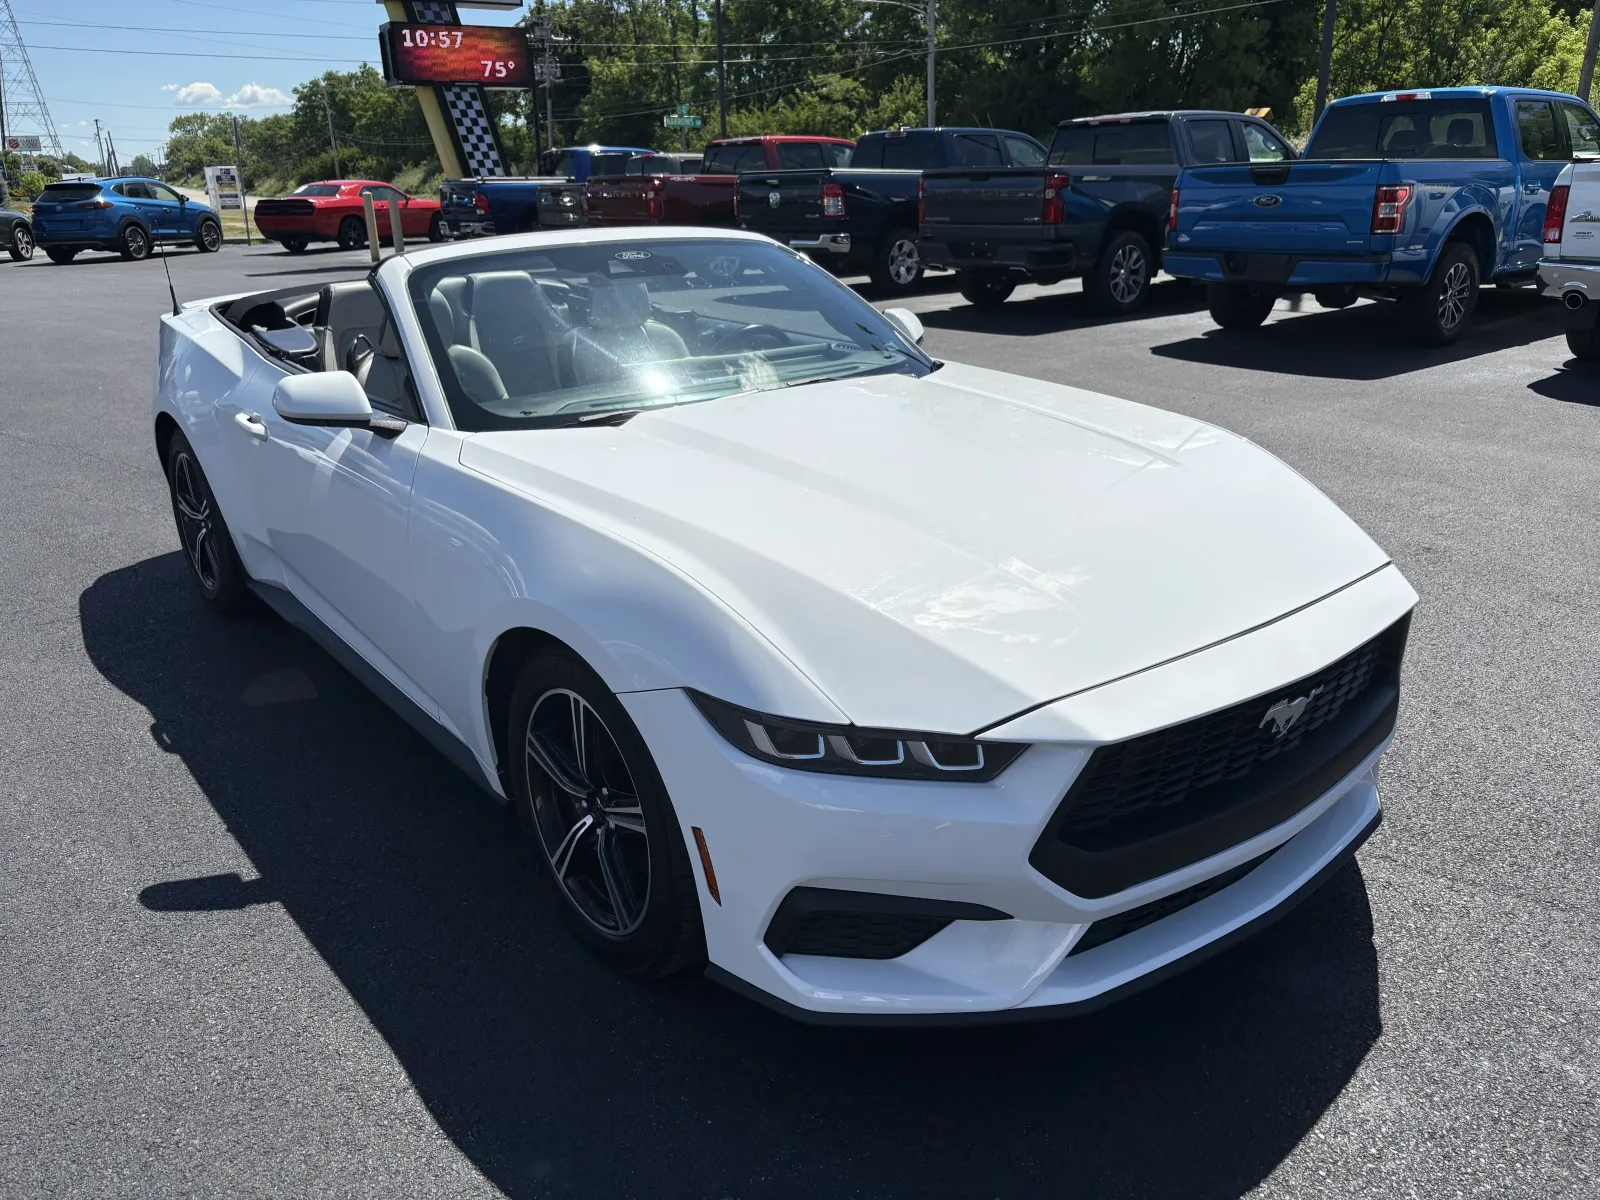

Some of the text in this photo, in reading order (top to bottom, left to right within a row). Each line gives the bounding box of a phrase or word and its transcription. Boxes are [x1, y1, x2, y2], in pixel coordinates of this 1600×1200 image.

[401, 29, 464, 49] 10:57
[480, 60, 516, 78] 75°
[1259, 196, 1275, 206] Ford
[622, 251, 645, 259] Ford
